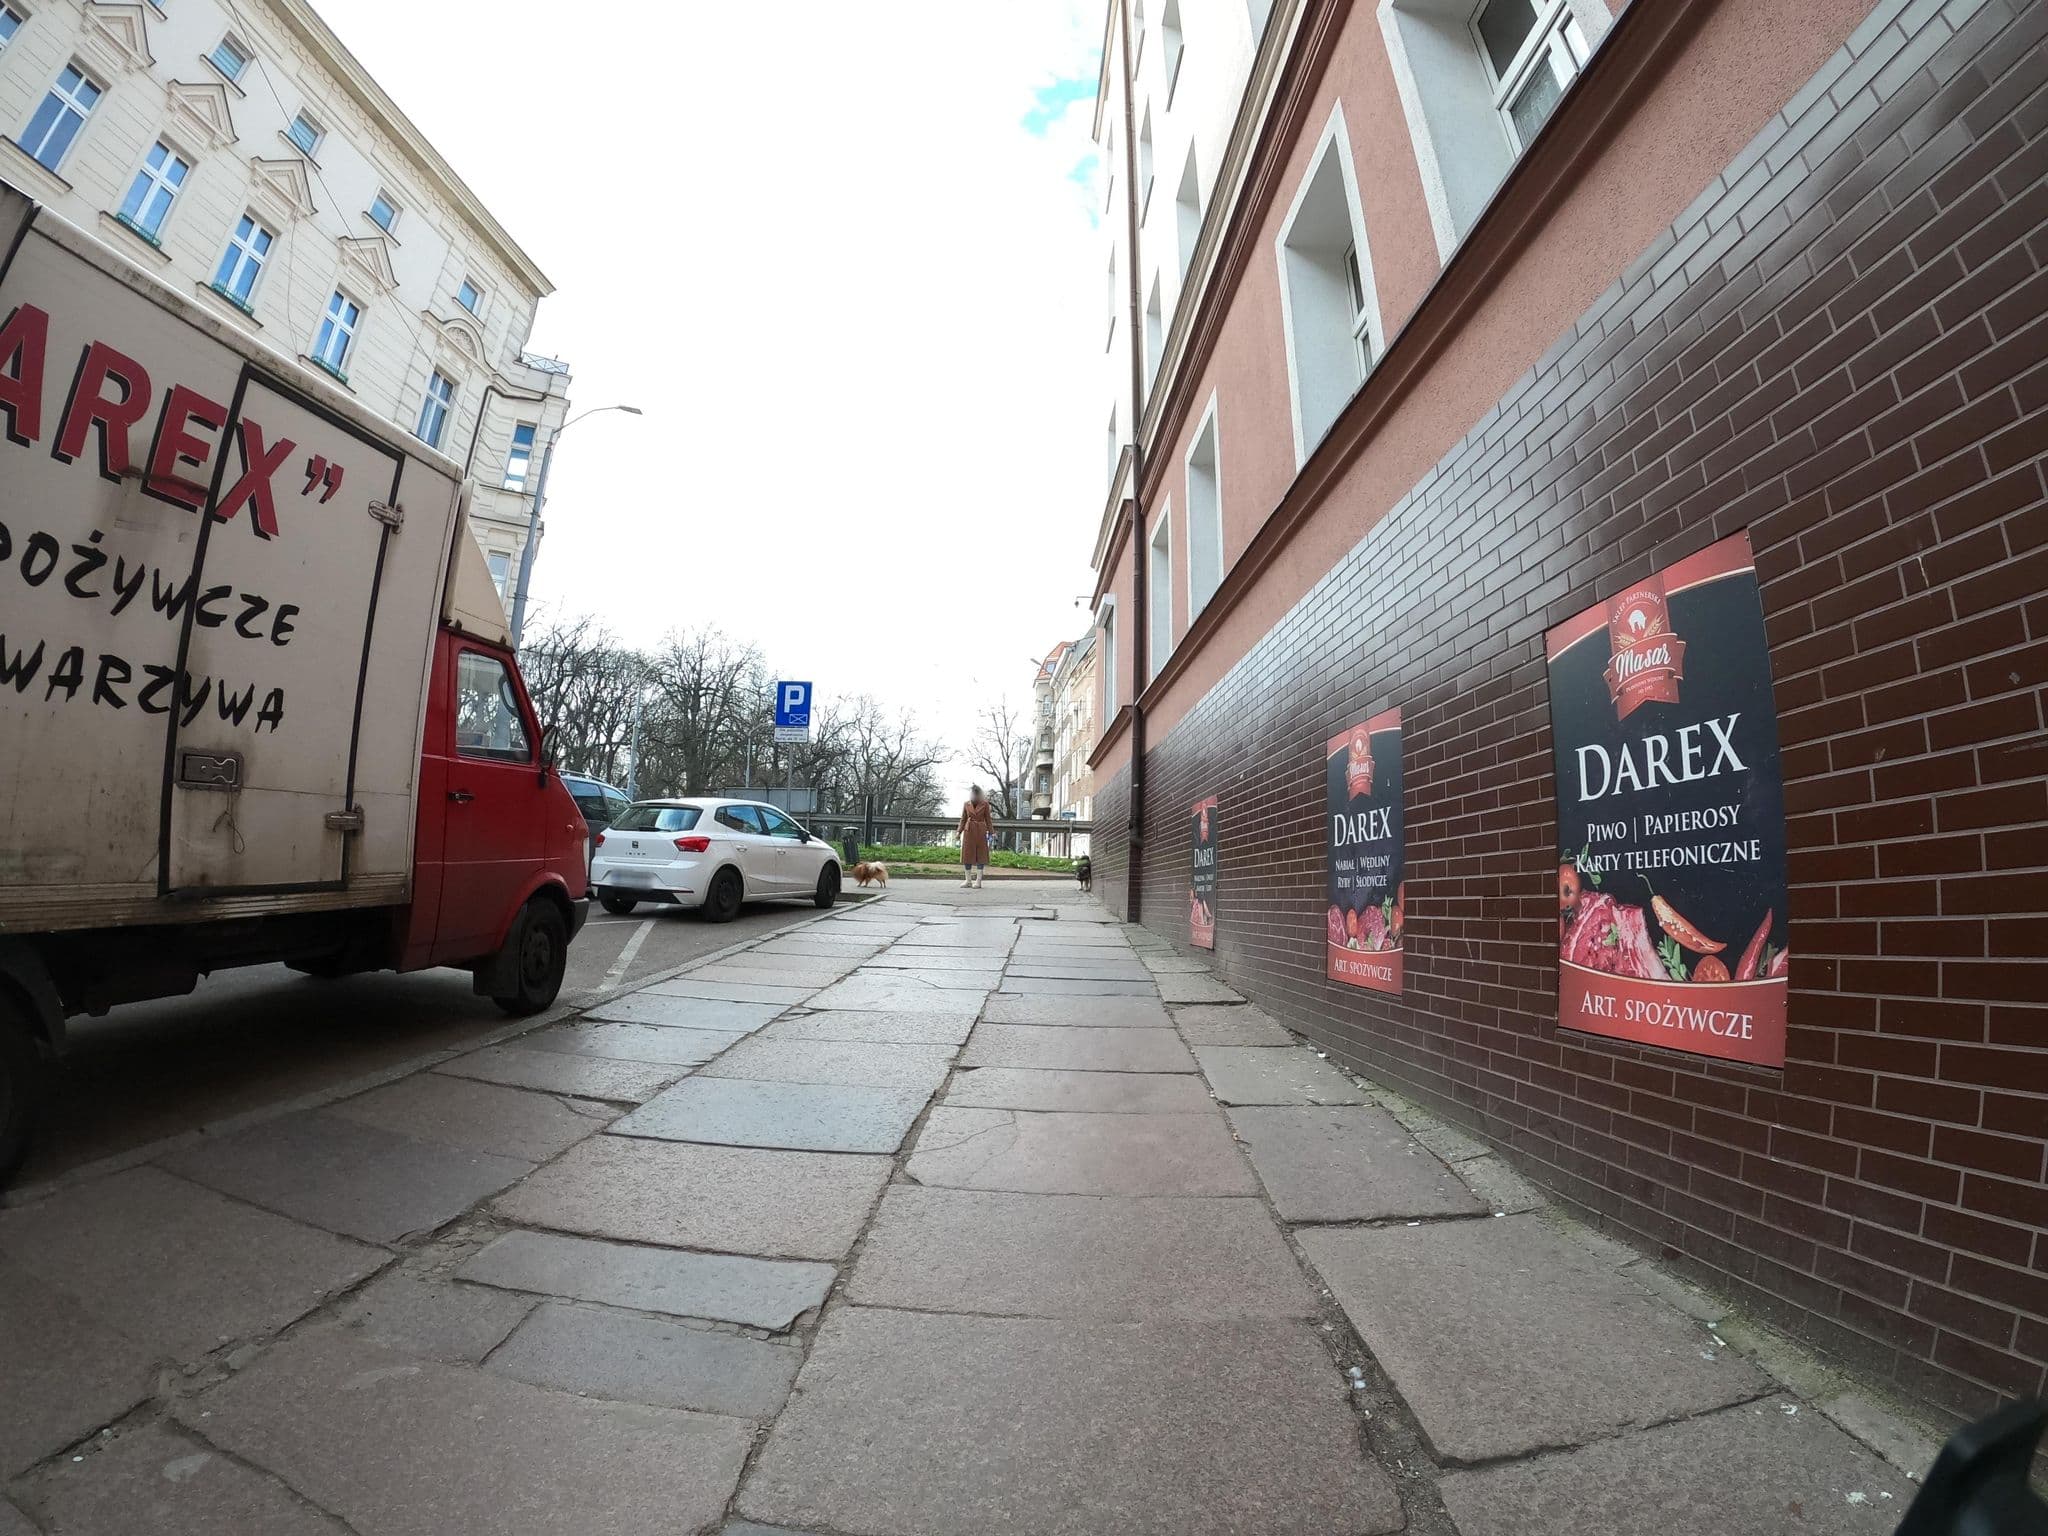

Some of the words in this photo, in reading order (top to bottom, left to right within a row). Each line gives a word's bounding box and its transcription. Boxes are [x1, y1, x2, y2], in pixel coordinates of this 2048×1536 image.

[1612, 602, 1626, 625] SKLEP
[1626, 591, 1661, 606] PARTNERSKI
[1615, 643, 1671, 682] Masar
[784, 685, 805, 713] P
[1575, 713, 1749, 801] DAREX
[1333, 806, 1392, 847] DAREX
[1587, 821, 1627, 843] PIWO
[1644, 804, 1741, 836] PAPIEROSY
[1194, 847, 1214, 868] DAREX
[1576, 853, 1620, 873] KARTY
[1625, 840, 1762, 870] TELEFONICZNE
[1350, 960, 1392, 981] SPOŻYWCZE
[1580, 990, 1618, 1017] ART.
[1625, 998, 1752, 1039] SPOŻYWCZE
